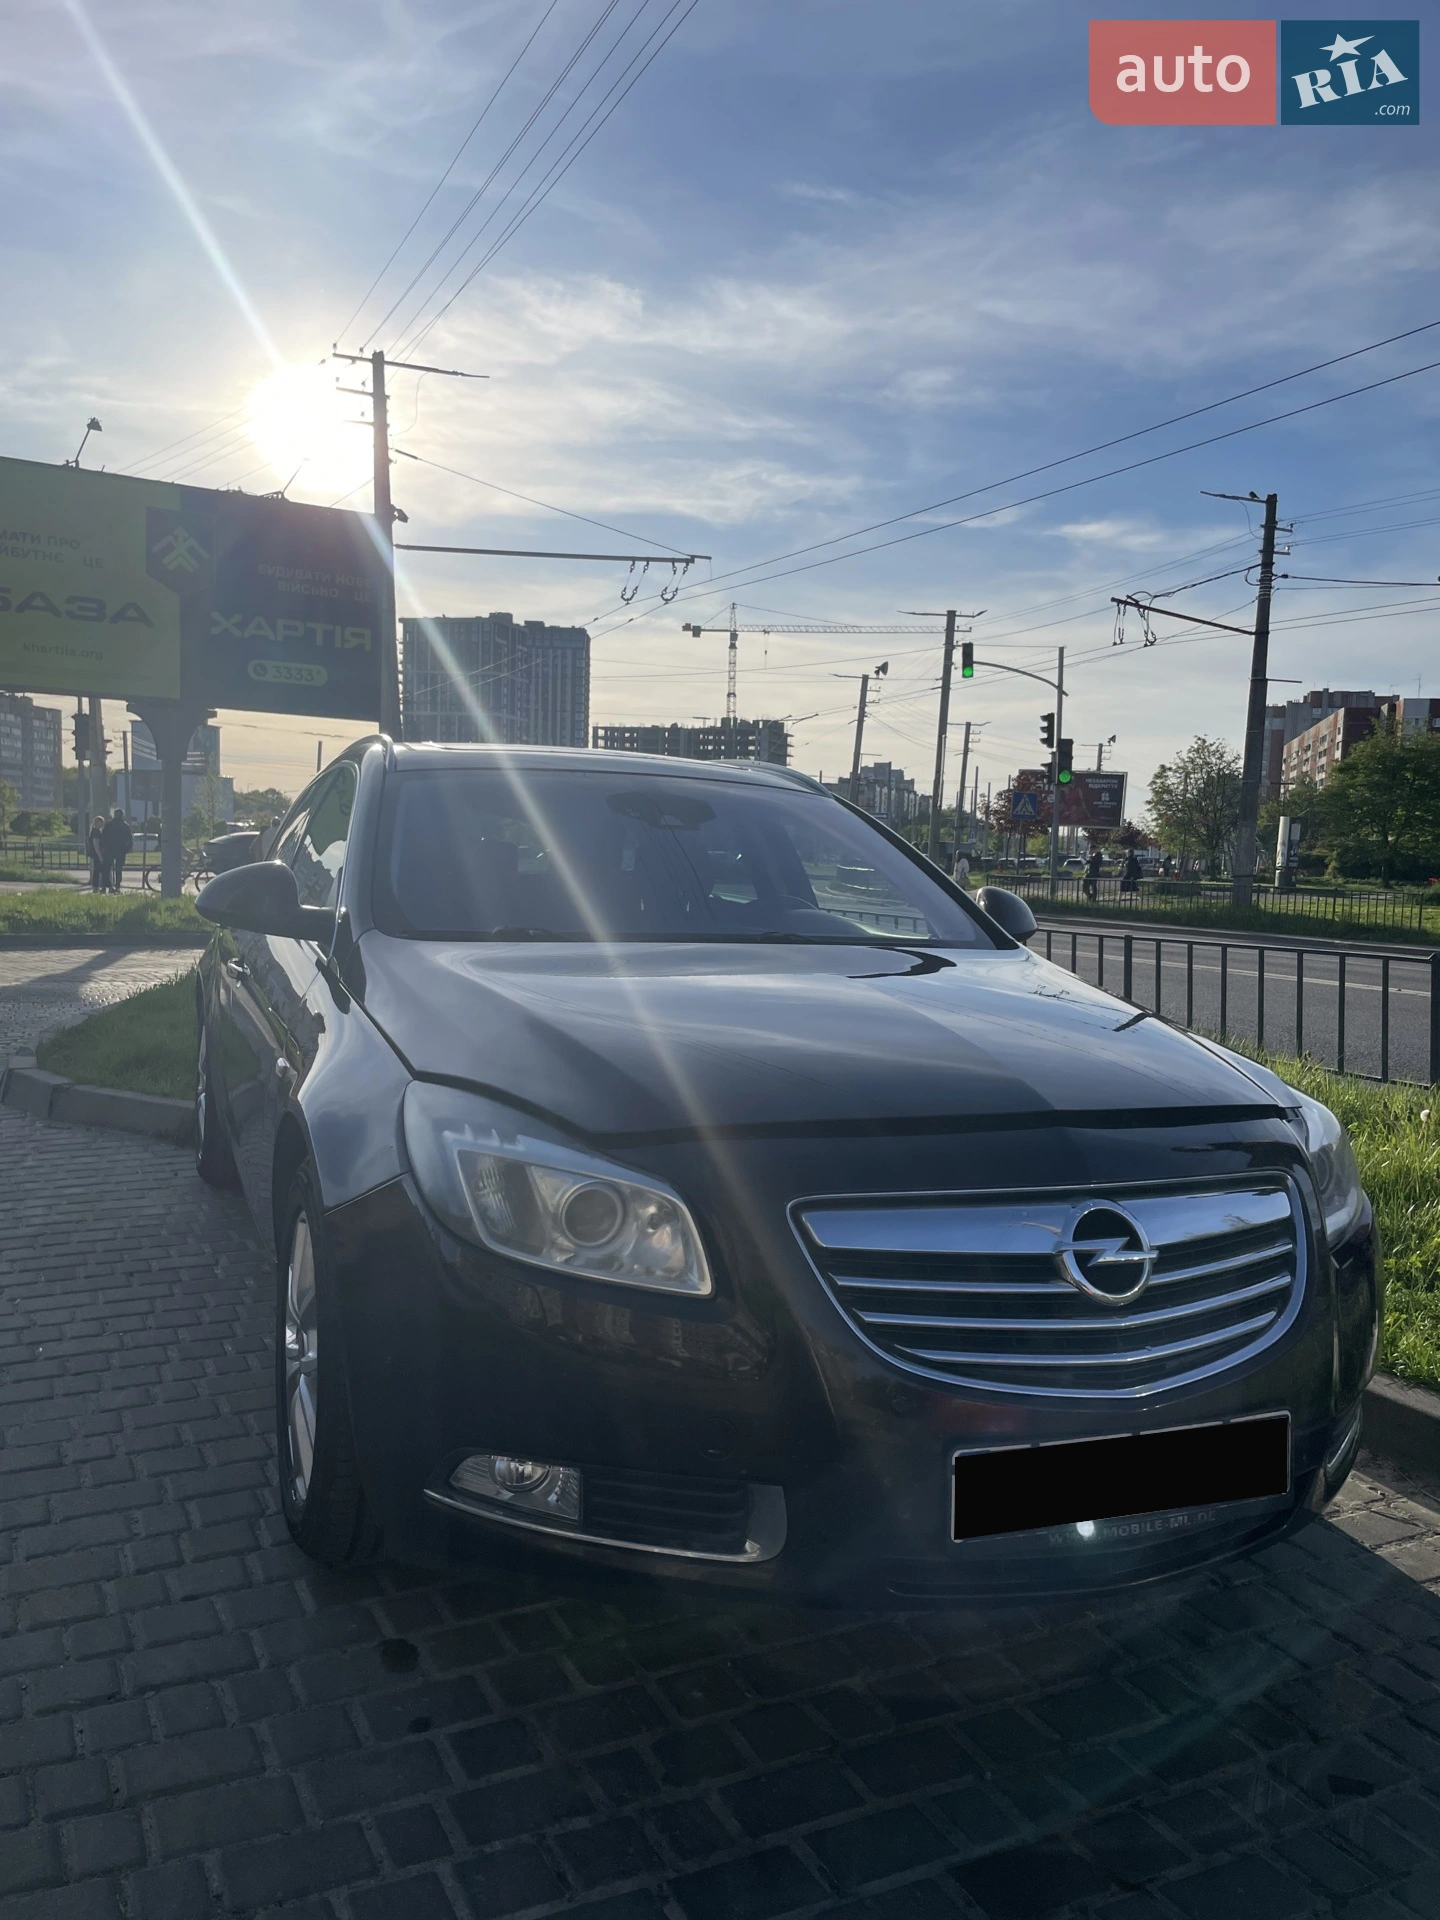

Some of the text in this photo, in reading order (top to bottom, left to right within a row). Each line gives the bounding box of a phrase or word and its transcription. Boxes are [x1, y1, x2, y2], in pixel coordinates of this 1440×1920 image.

[47, 535, 80, 550] ПРО
[82, 556, 104, 569] ЦЕ
[277, 580, 338, 598] ВІЙСЬКО
[335, 573, 373, 589] НОВЕ
[210, 610, 371, 652] ХАРТІЯ
